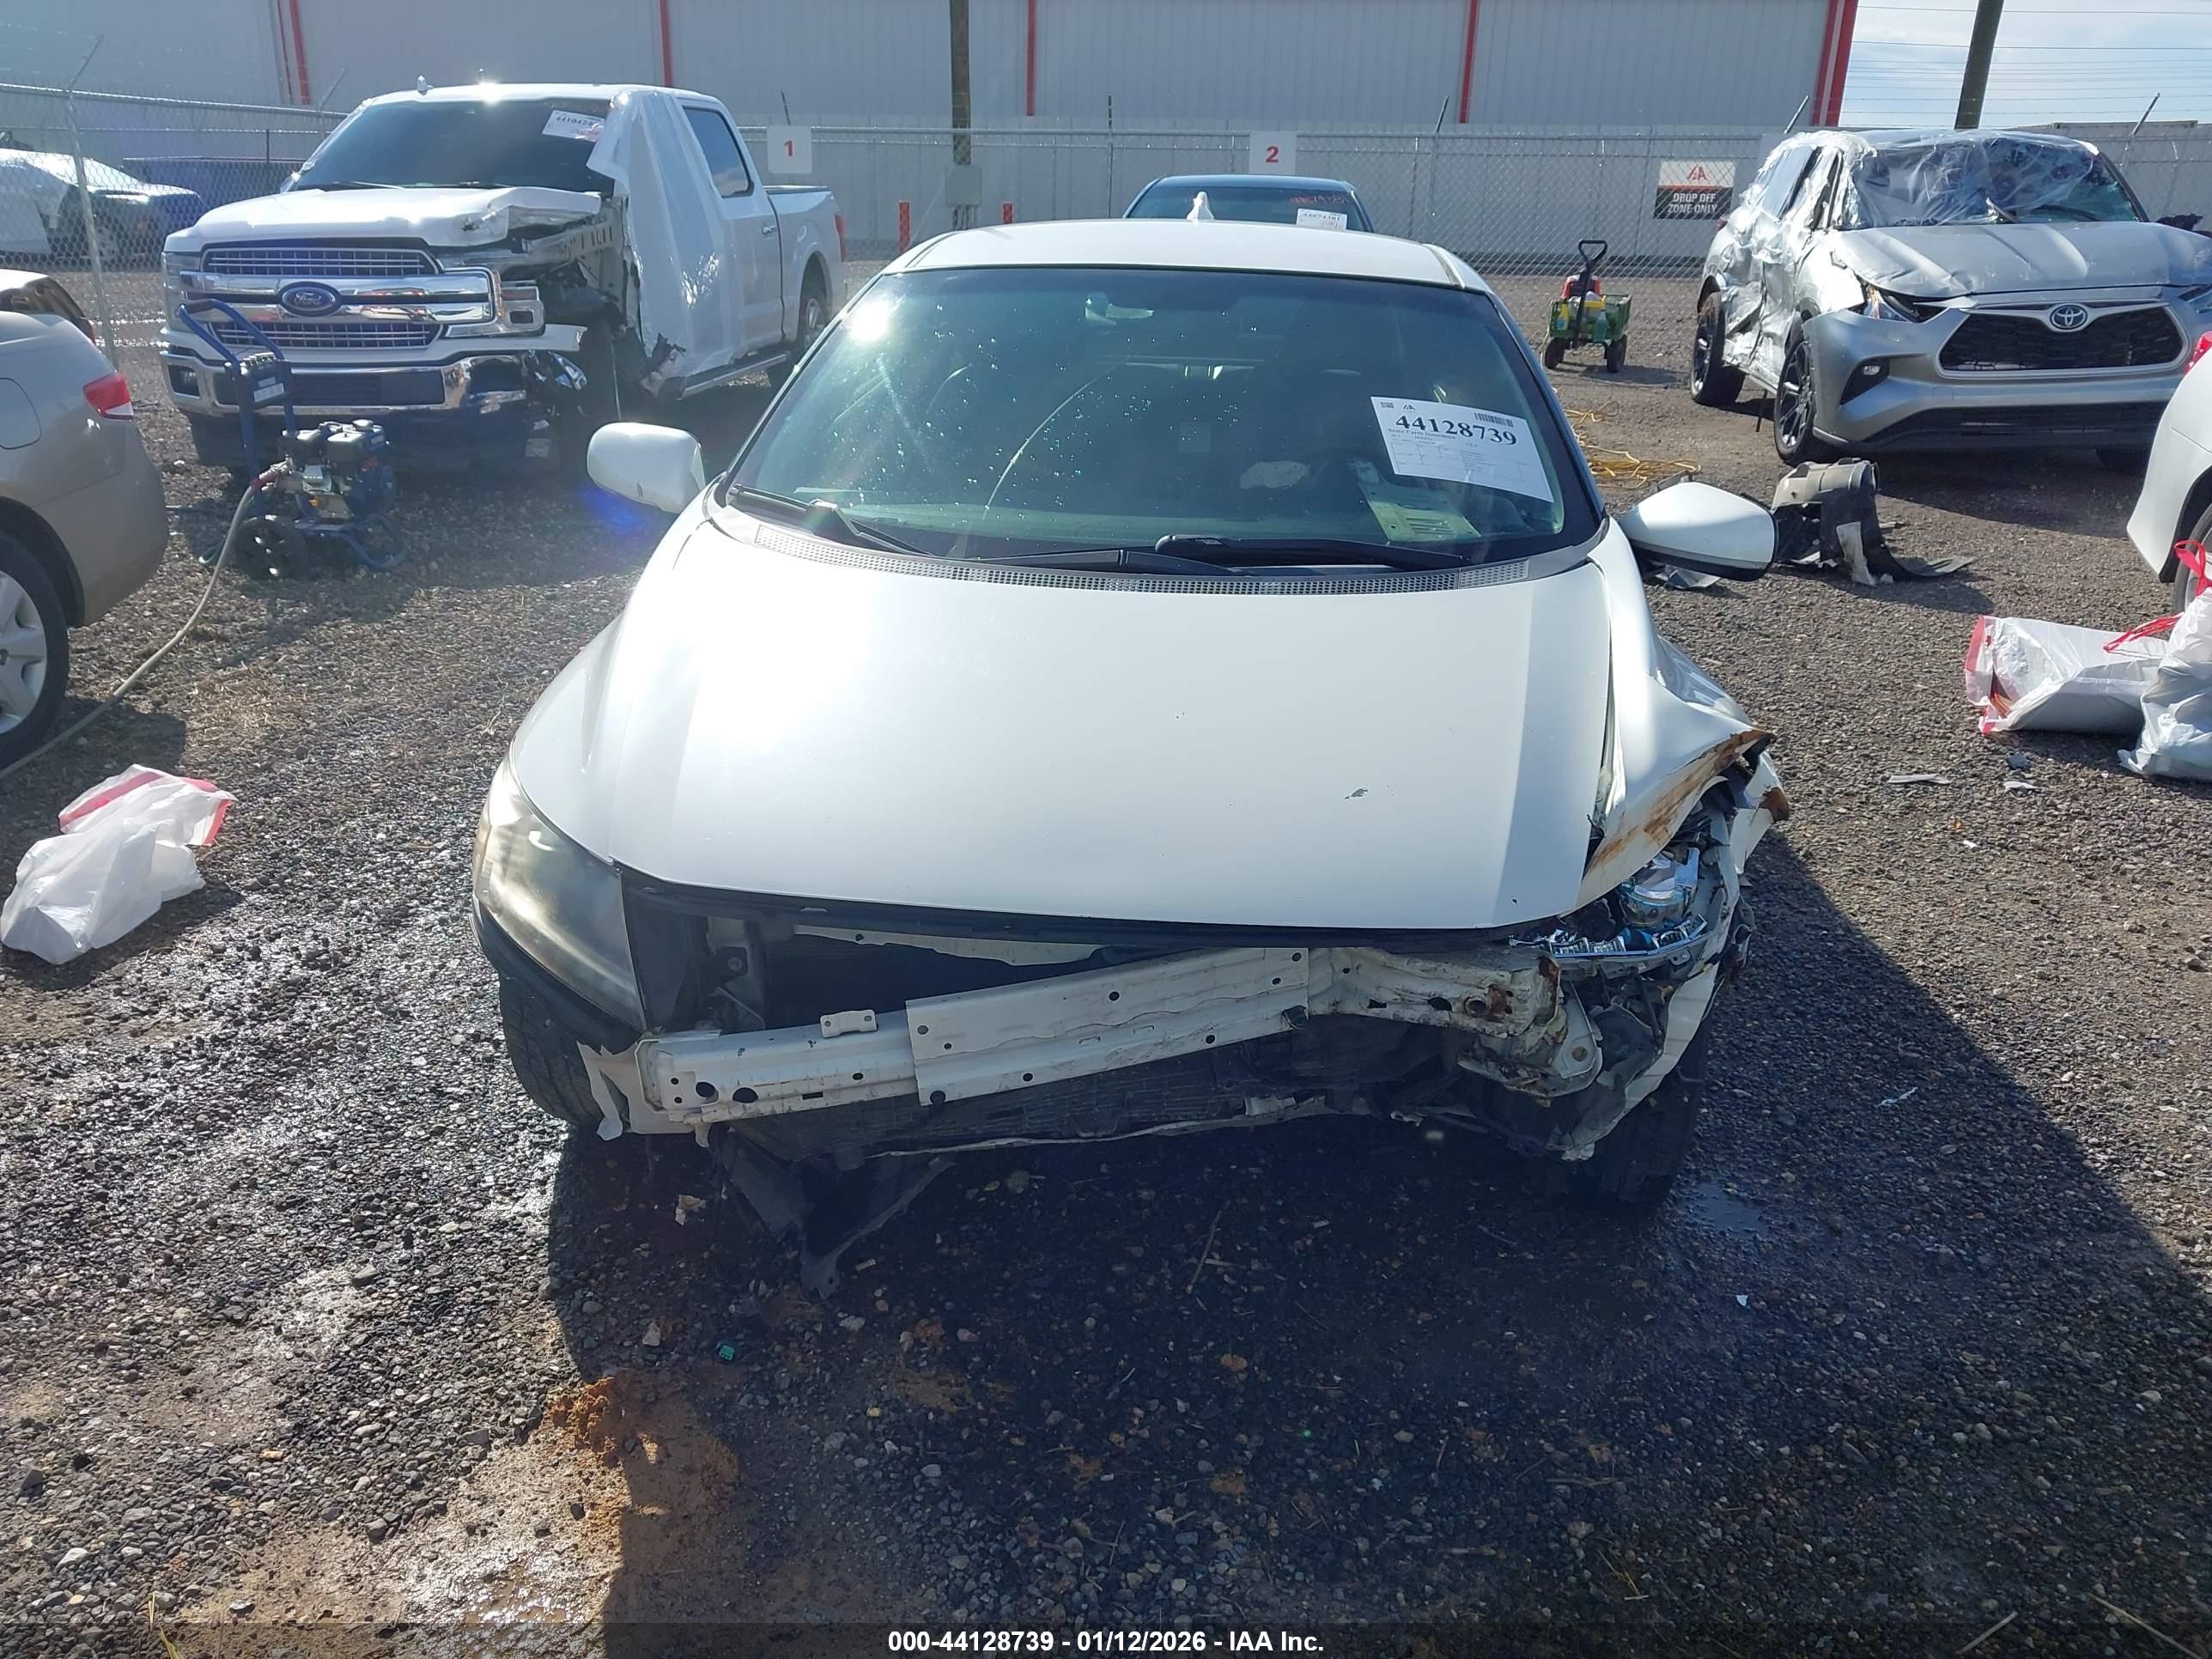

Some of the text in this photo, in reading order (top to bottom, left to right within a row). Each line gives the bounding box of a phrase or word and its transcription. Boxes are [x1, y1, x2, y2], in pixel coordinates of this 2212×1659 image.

[784, 140, 793, 156] 1
[1266, 145, 1279, 163] 2
[1673, 192, 1716, 203] DROP OFF
[1668, 204, 1718, 214] ZONE ONLY
[295, 291, 322, 303] Ford
[1395, 415, 1516, 445] 44128739
